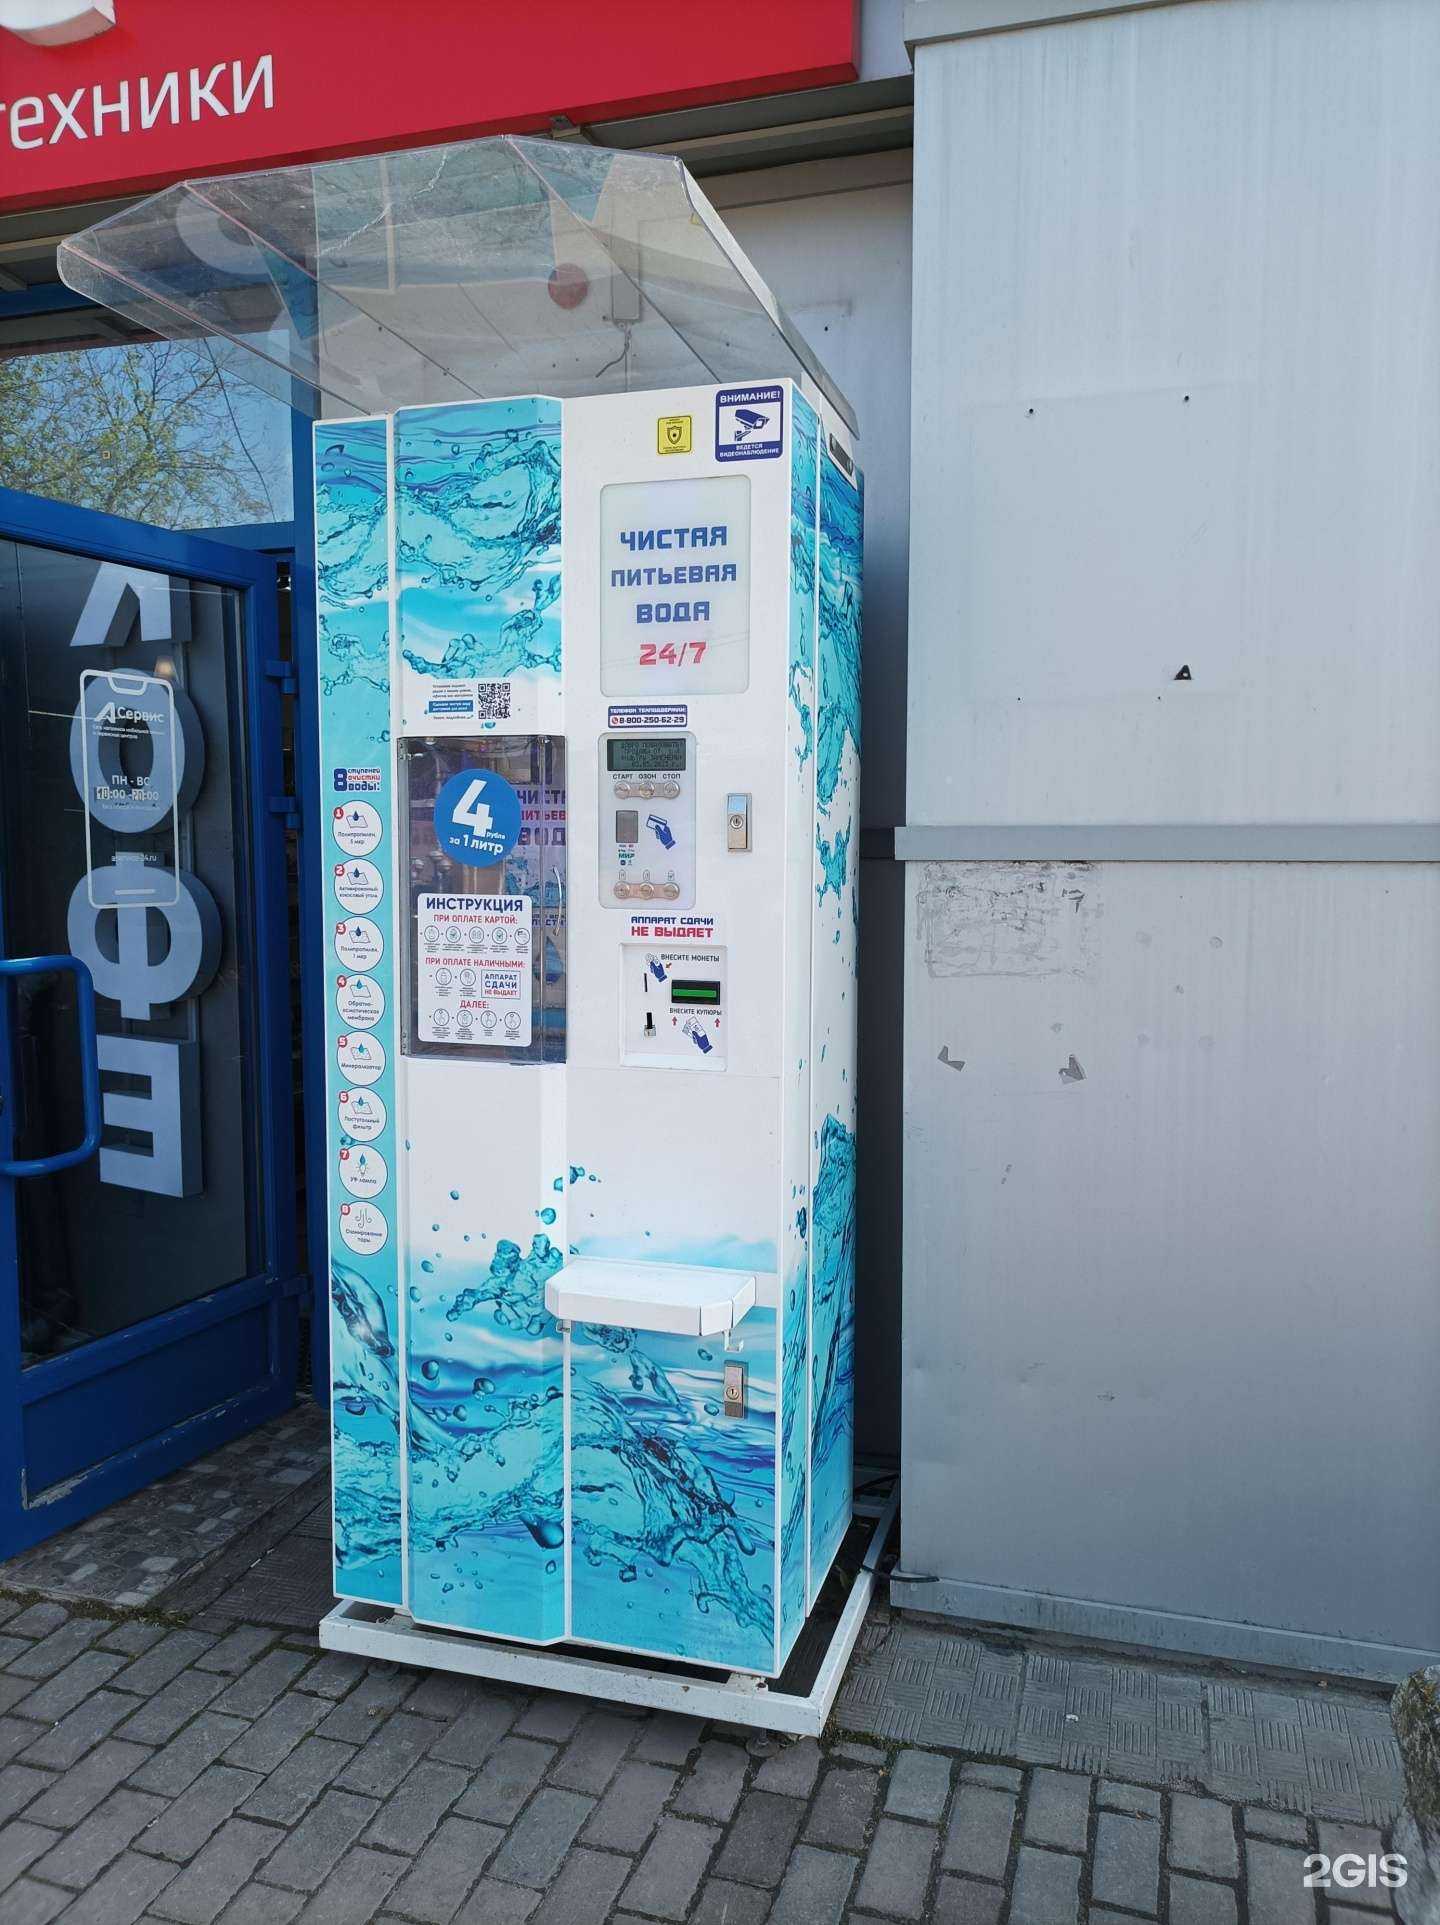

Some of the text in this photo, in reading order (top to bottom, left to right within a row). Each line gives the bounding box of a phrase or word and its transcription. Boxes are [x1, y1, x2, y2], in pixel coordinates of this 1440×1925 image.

[0, 54, 275, 150] ехники
[720, 390, 780, 403] ВНИМАНИЕ!
[720, 448, 779, 457] ВИДЕОНАБЛЮДЕНИЕ
[736, 443, 762, 451] ВЕДЕТСЯ
[620, 525, 727, 552] ЧИСТАЯ
[611, 563, 737, 587] ПИТЬЕВАЯ
[636, 600, 710, 624] ВОДА
[639, 641, 706, 667] 24/7
[117, 706, 165, 723] Сервис
[112, 775, 128, 785] ПН
[137, 776, 151, 786] ВС
[334, 768, 347, 791] 8
[452, 779, 493, 837] 4
[449, 834, 504, 855] за 1 литр
[336, 866, 343, 875] 2
[426, 898, 523, 913] ИНСТРУКЦИЯ
[434, 914, 518, 925] ПРИ ОПЛАТЕ КАРТОЙ:
[631, 916, 714, 925] АППАРАТ СДАЧИ
[337, 924, 344, 933] 3
[631, 926, 714, 938] НЕ ВЫДАЕТ
[425, 957, 526, 968] ПРИ ОПЛАТЕ НАЛИЧНЫМИ:
[338, 977, 346, 986] 4
[485, 981, 517, 989] СДАЧИ
[460, 1000, 490, 1009] ДАЛЕЕ:
[696, 1008, 722, 1016] КУПЮРЫ
[339, 1037, 346, 1047] 5
[340, 1093, 347, 1102] 6
[342, 1150, 348, 1159] 7
